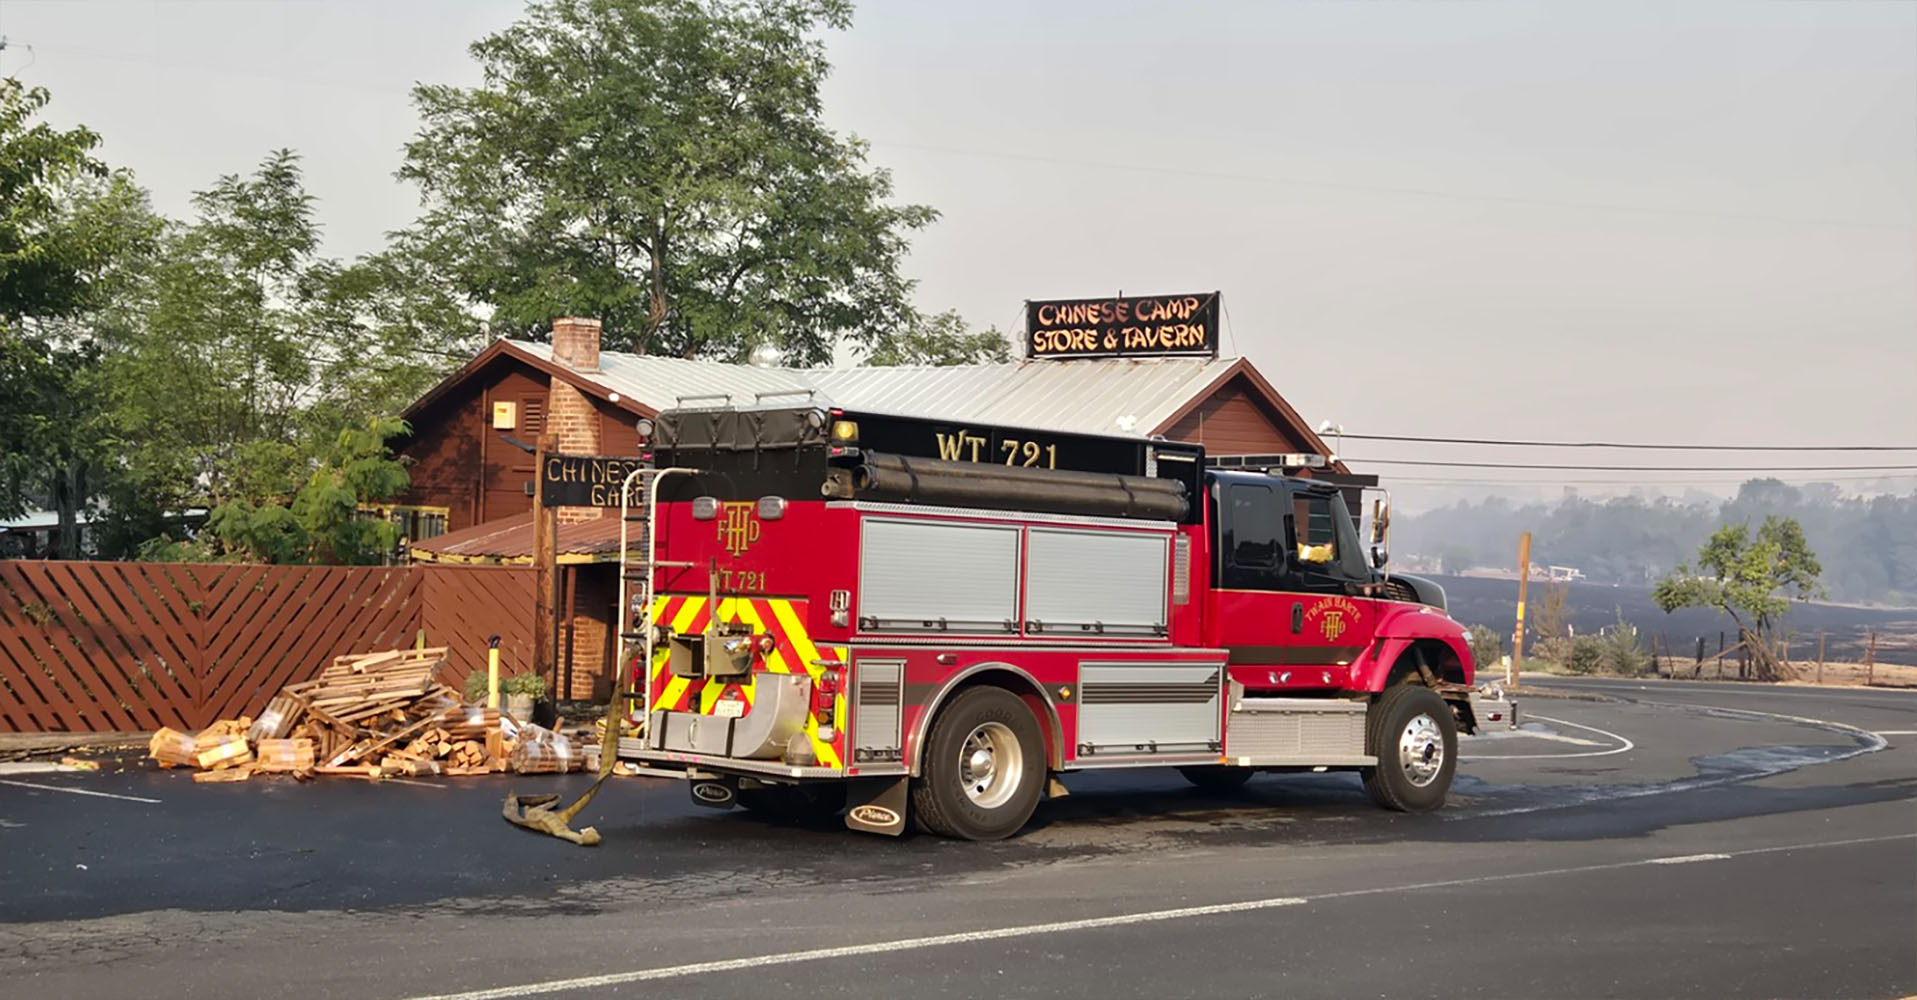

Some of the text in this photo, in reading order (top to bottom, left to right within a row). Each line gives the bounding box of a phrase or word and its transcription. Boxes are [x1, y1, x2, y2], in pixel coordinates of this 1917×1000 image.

[1038, 296, 1200, 327] CHINESE CAMP
[1033, 324, 1205, 352] STORE & TAVERN
[935, 429, 1057, 471] WT 721
[738, 571, 765, 591] 721
